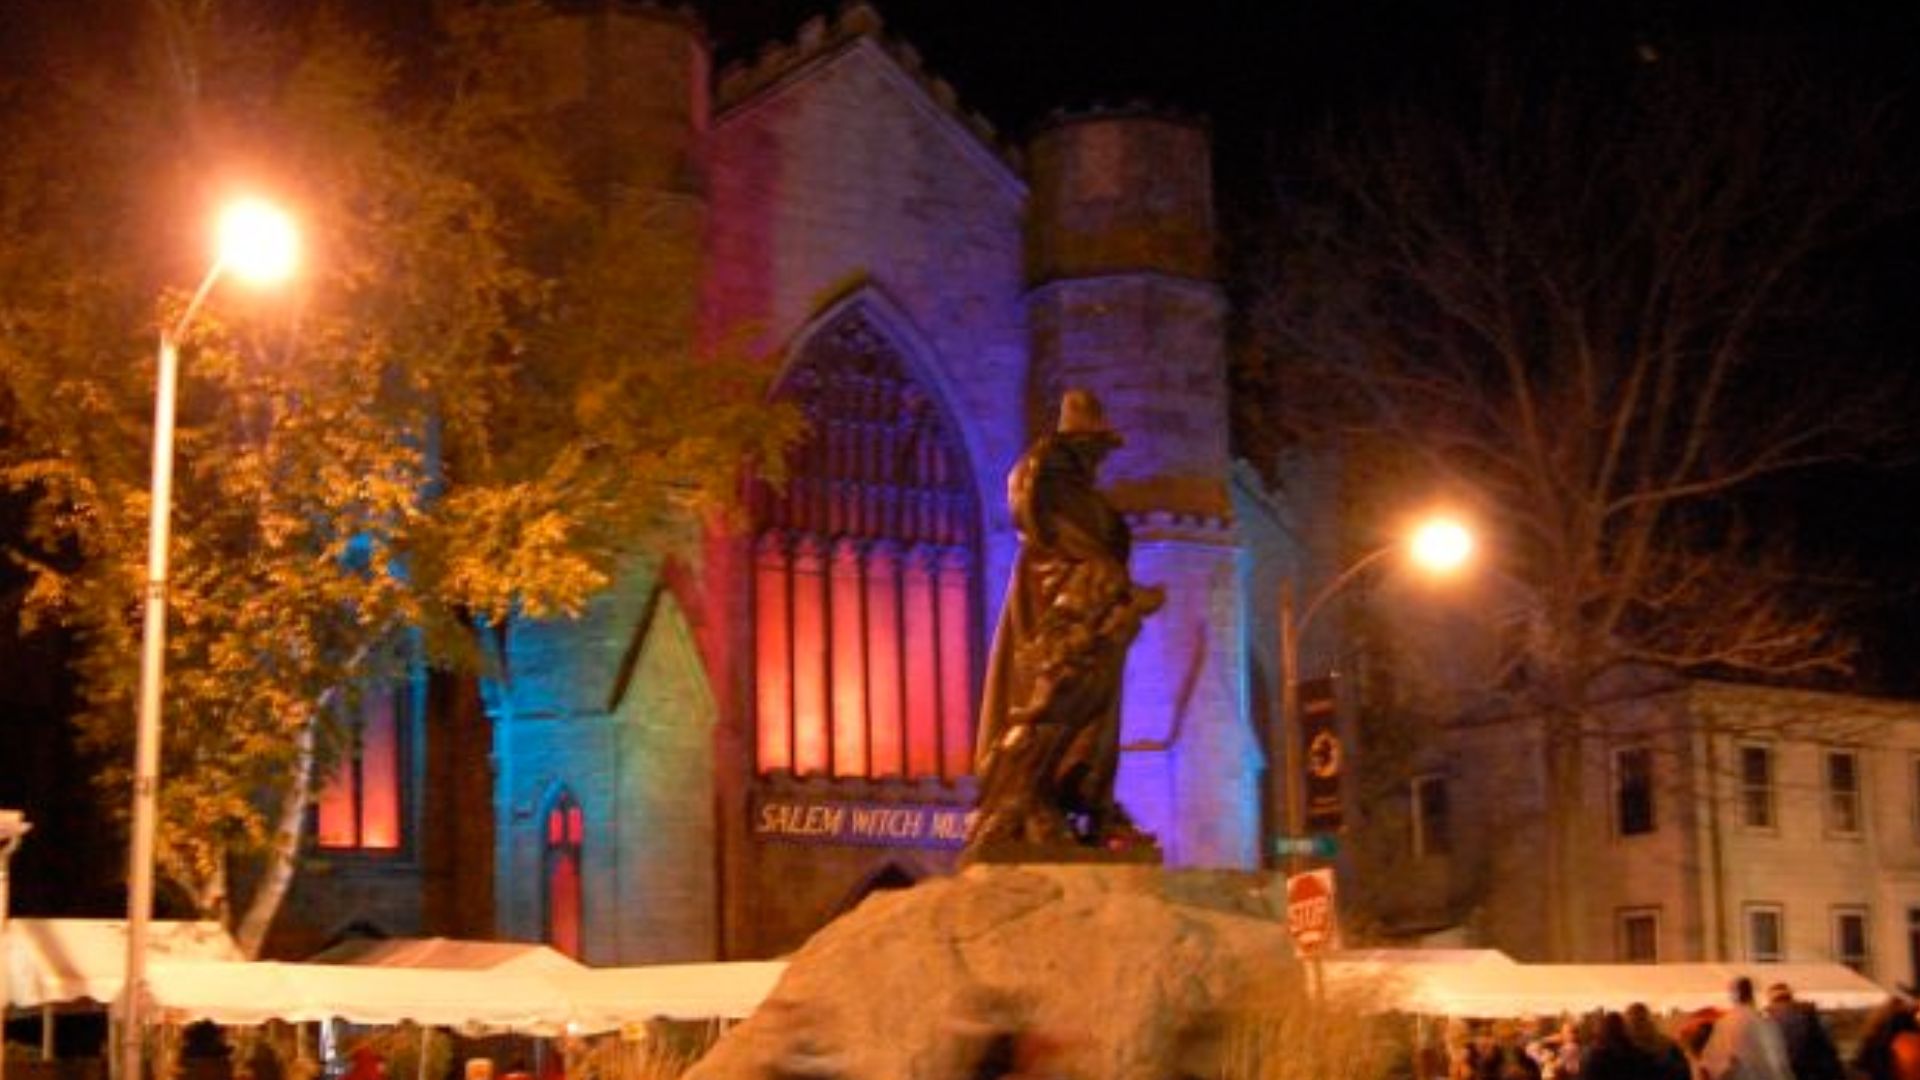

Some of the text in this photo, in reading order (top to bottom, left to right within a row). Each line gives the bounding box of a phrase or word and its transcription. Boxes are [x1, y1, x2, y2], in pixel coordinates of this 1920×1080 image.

[758, 803, 842, 836] SALEM
[852, 808, 922, 839] WITCH
[1287, 897, 1329, 929] STOP
